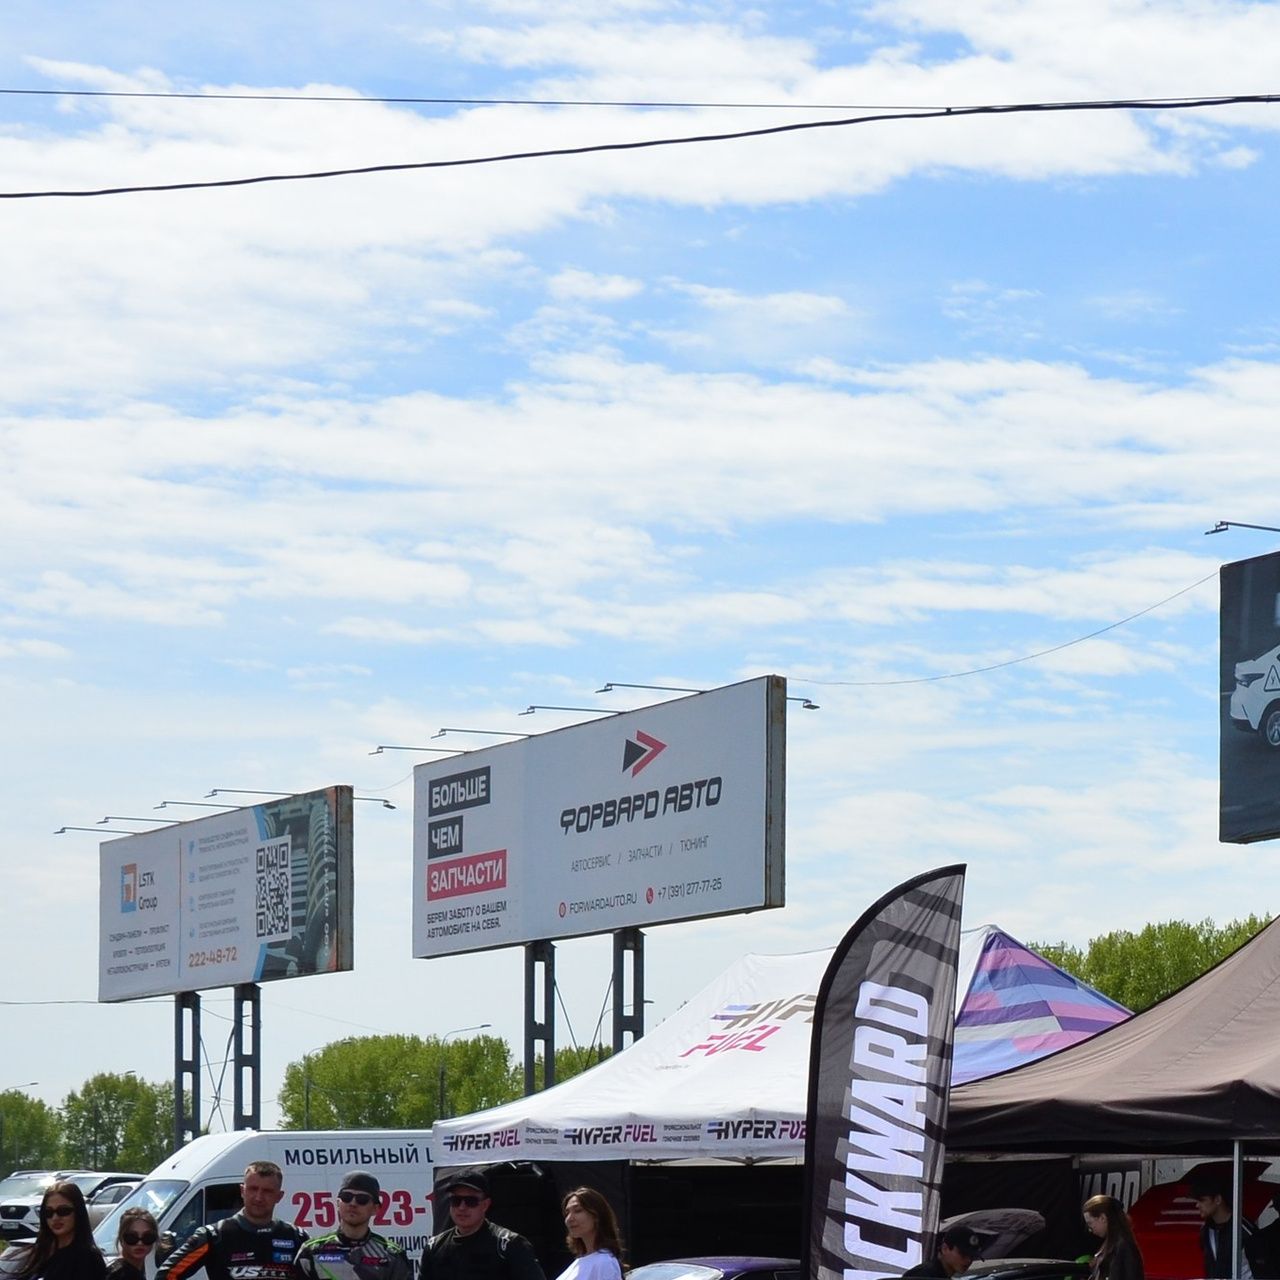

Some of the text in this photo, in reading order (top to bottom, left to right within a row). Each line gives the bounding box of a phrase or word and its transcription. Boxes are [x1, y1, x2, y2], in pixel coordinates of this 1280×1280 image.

[432, 775, 487, 809] БОЛЬШЕ
[560, 776, 723, 836] ФОРВАРД АВТО
[431, 824, 460, 850] ЧЕМ
[571, 854, 612, 873] АВТОСЕРВИС
[628, 845, 663, 862] ЗАПЧАСТИ
[680, 835, 709, 852] ТЮНИНГ
[139, 871, 155, 887] LSTK
[430, 858, 503, 893] ЗАПЧАСТИ
[139, 896, 158, 911] Group
[569, 893, 638, 915] FORWARDAUTO.RU
[686, 877, 722, 896] 277-77-25
[427, 911, 448, 925] БЕРЕМ
[449, 906, 474, 919] ЗАБОТУ
[482, 900, 507, 914] ВАШЕМ
[427, 916, 501, 939] АВТОМОБИЛЕ НА СЕБЯ.
[189, 946, 237, 968] 222-48-72
[678, 1024, 782, 1058] FUEL
[443, 1133, 492, 1152] HYPER
[492, 1129, 521, 1147] FUEL
[563, 1124, 658, 1146] HYPER FUEL
[707, 1120, 808, 1141] HYPER FUE
[285, 1143, 419, 1166] МОБИЛЬНЫЙ
